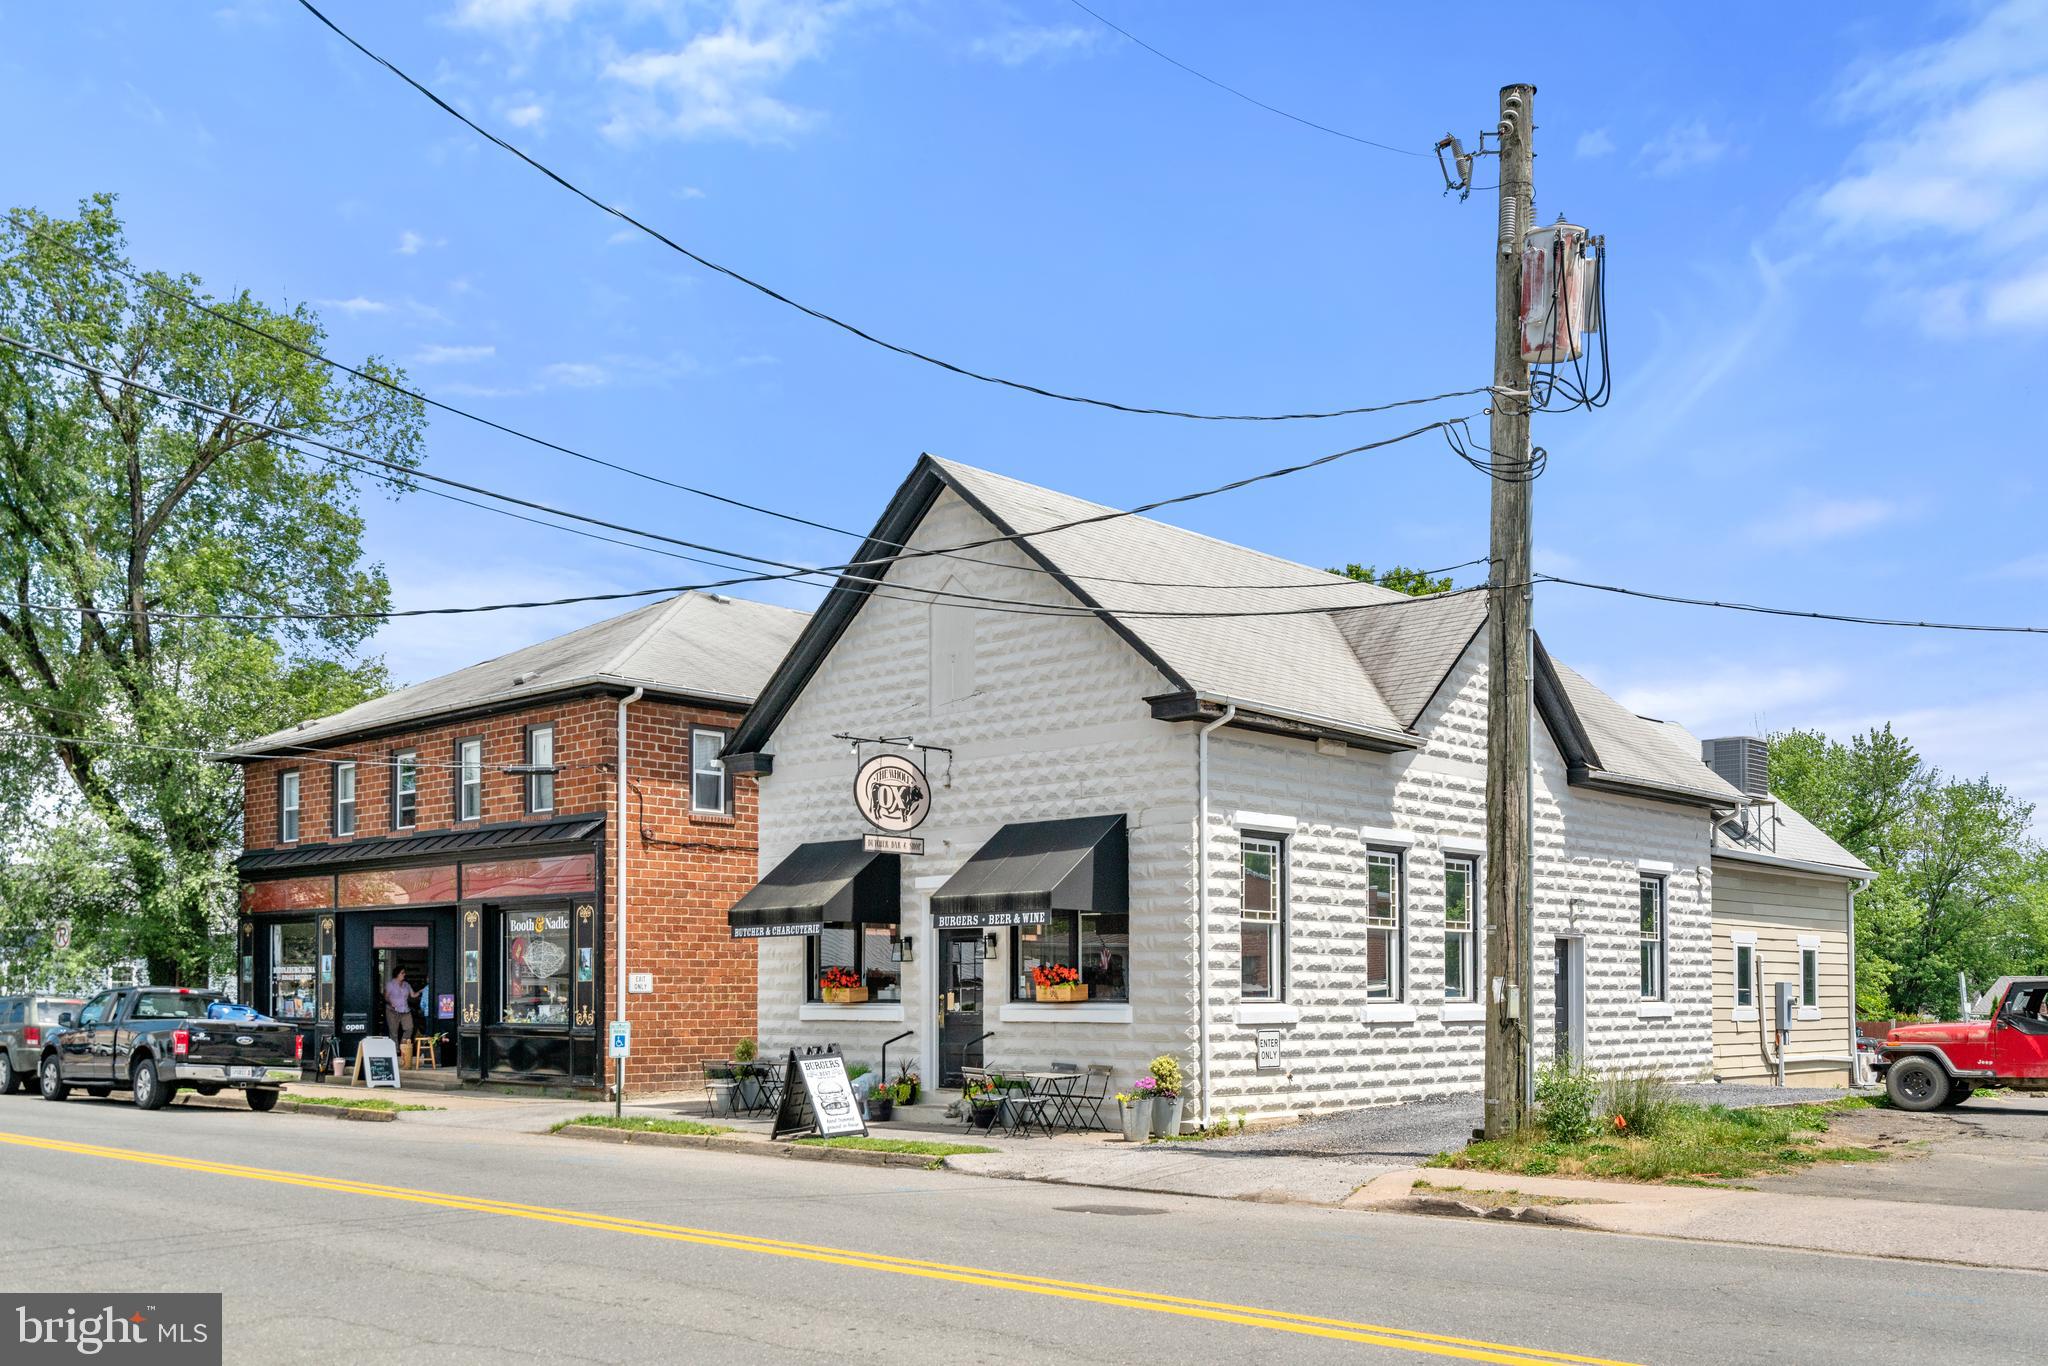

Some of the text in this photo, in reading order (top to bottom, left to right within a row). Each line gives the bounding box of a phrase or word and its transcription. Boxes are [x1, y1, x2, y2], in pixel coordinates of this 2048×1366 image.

[879, 785, 905, 812] OX
[510, 918, 534, 931] Booth
[535, 916, 544, 933] &
[939, 912, 1045, 927] BURGERS BEER & WINE
[734, 924, 820, 937] BUTCHER & CHARCUTERIE
[1260, 1039, 1278, 1047] ENTER
[1261, 1051, 1277, 1059] ONLY
[804, 1060, 840, 1071] BURGERS
